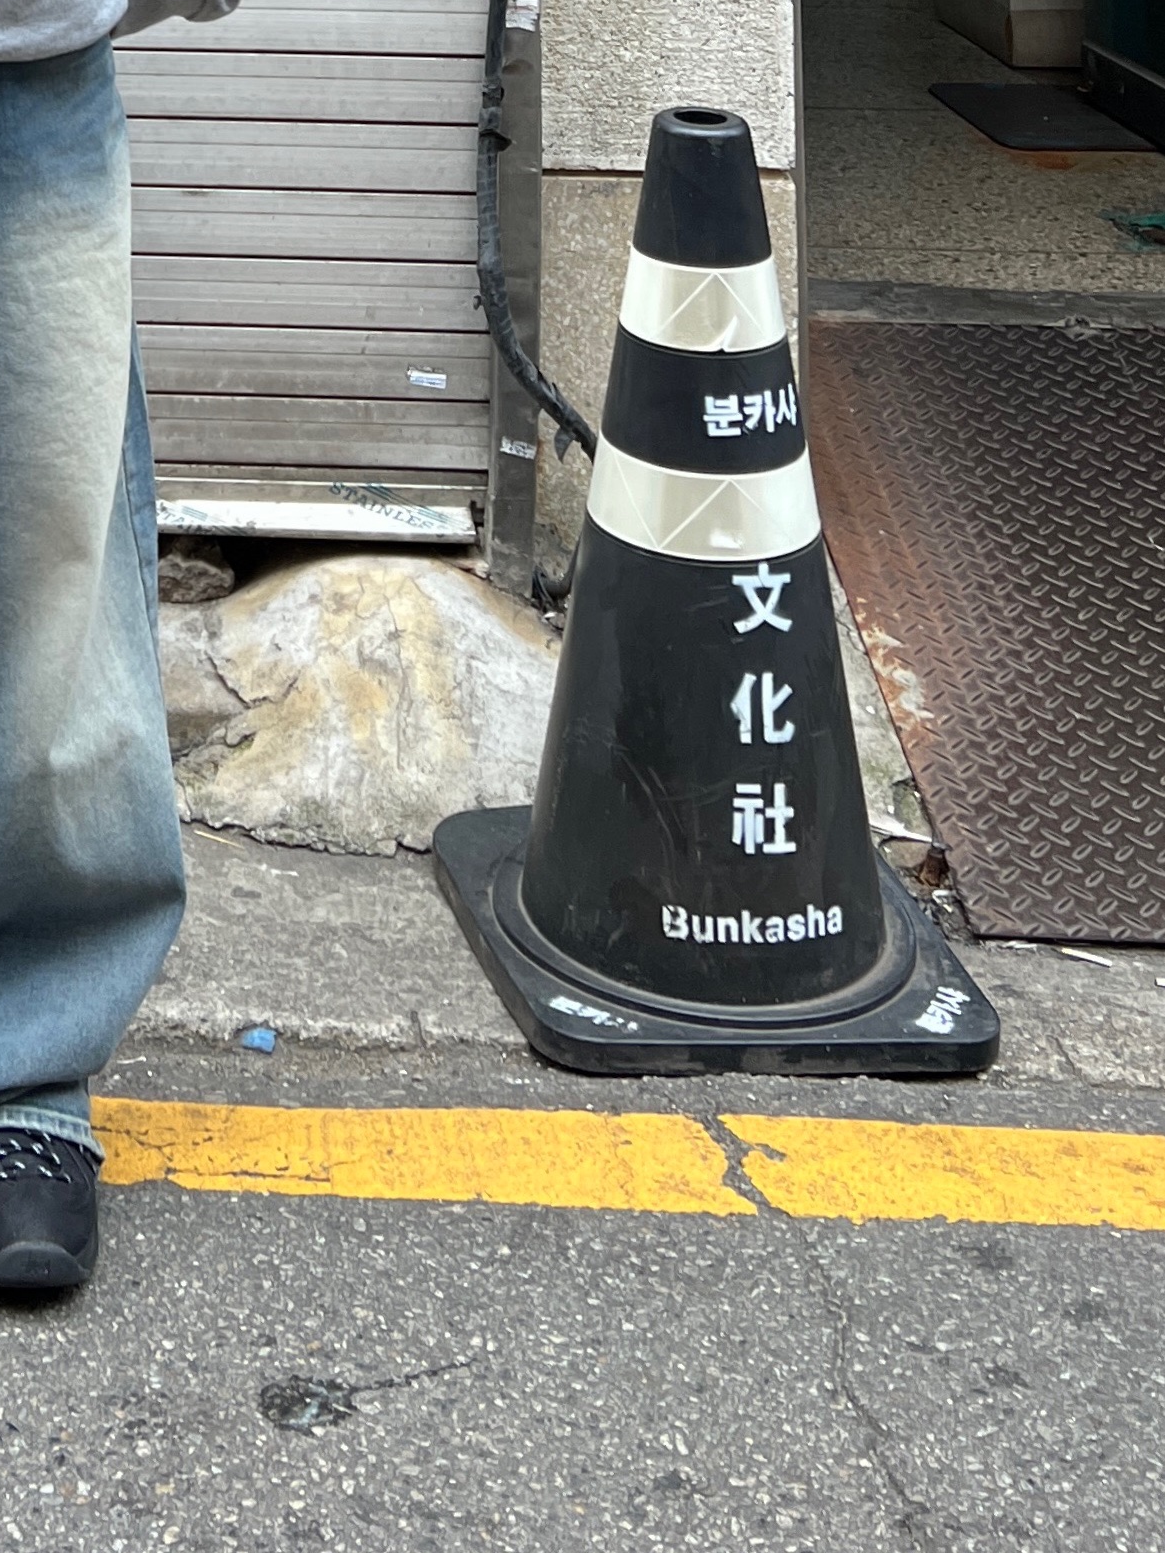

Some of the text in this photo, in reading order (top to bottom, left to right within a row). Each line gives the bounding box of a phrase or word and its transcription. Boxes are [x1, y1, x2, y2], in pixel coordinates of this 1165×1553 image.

[702, 382, 797, 437] 분카사
[730, 561, 796, 855] 文化社
[661, 903, 843, 945] Bunkasha
